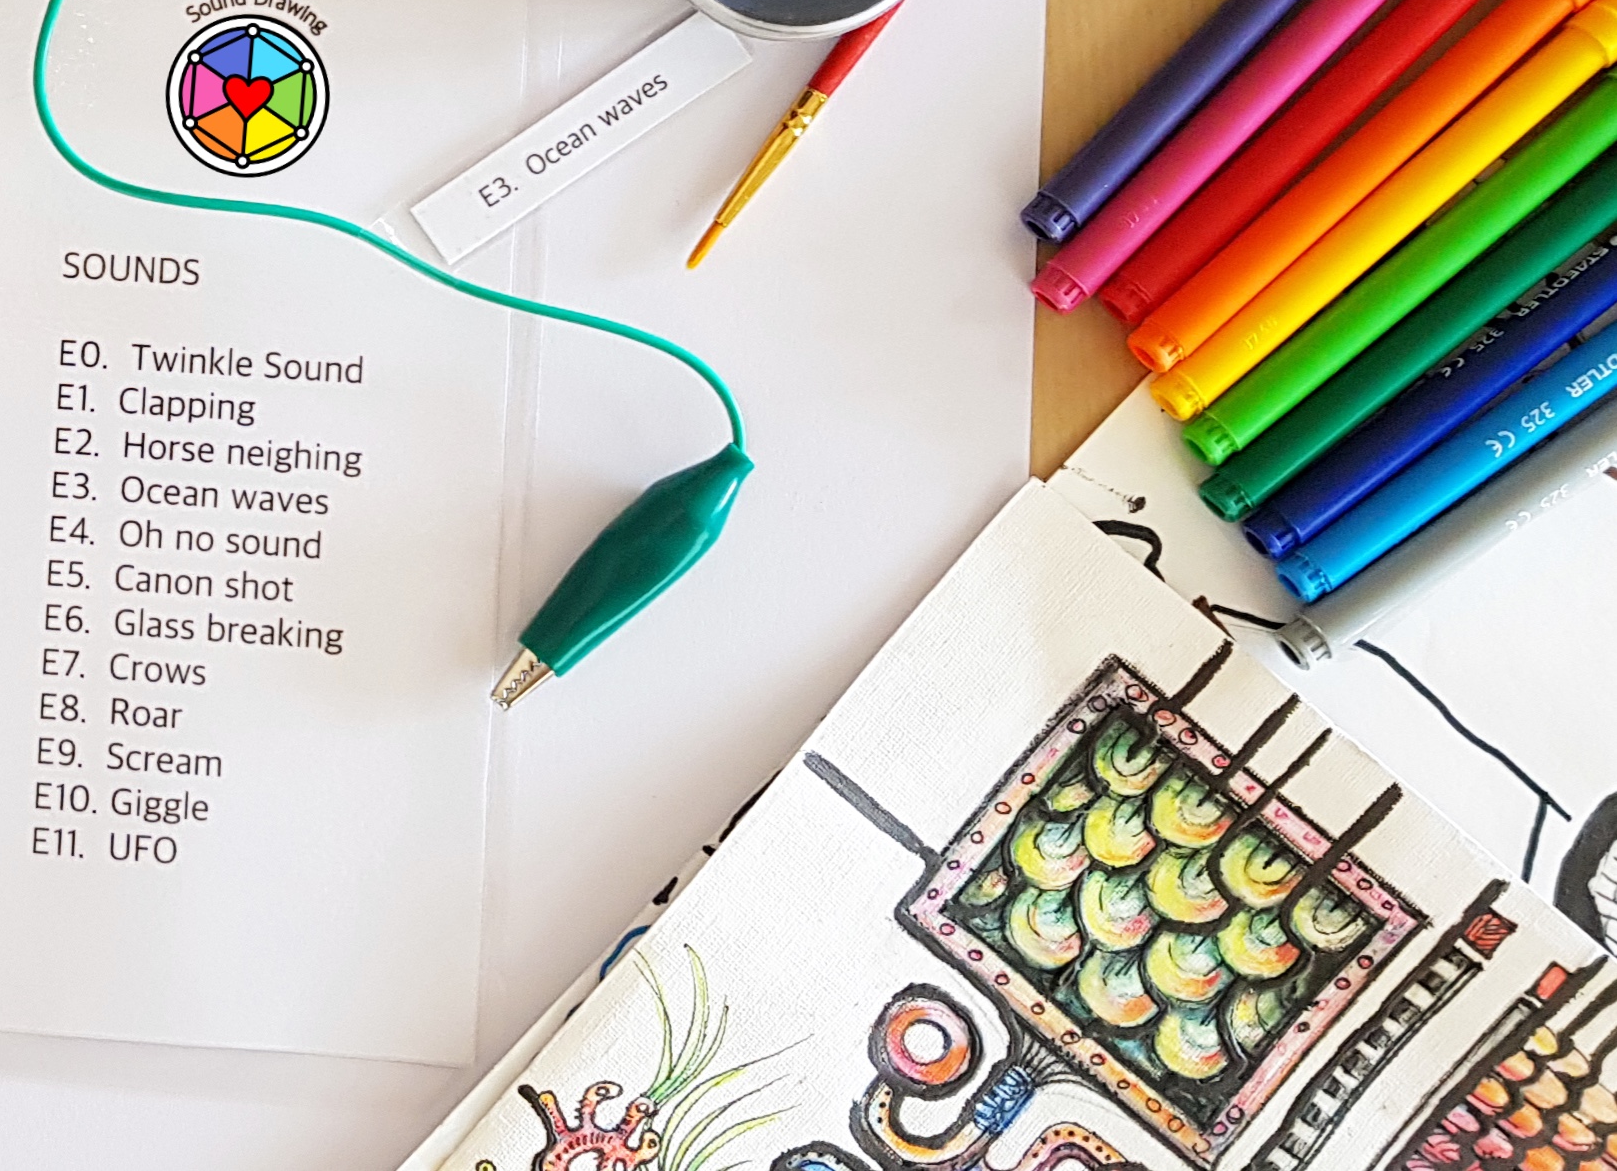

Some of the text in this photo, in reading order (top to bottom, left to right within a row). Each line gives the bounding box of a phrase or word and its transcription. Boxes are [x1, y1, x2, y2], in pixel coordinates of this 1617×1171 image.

[477, 74, 669, 208] E3. Ocean waves
[62, 251, 200, 286] SOUNDS
[59, 339, 364, 385] E0. Twinkle Sound
[56, 382, 257, 427] E1. Clapping
[1520, 401, 1556, 433] 325
[54, 426, 364, 479] E2. Horse neighing
[52, 470, 329, 516] E3. Ocean waves
[49, 514, 322, 560] E4. Oh no sound
[47, 559, 294, 603] E5. Canon shot
[44, 603, 345, 656] E6. Glass breaking
[42, 647, 207, 687] E7. Crows
[39, 692, 184, 729] E8. Roar
[37, 736, 222, 778] E9. Scream
[34, 781, 209, 825] E10. Giggle
[32, 826, 178, 865] E11. UFO
